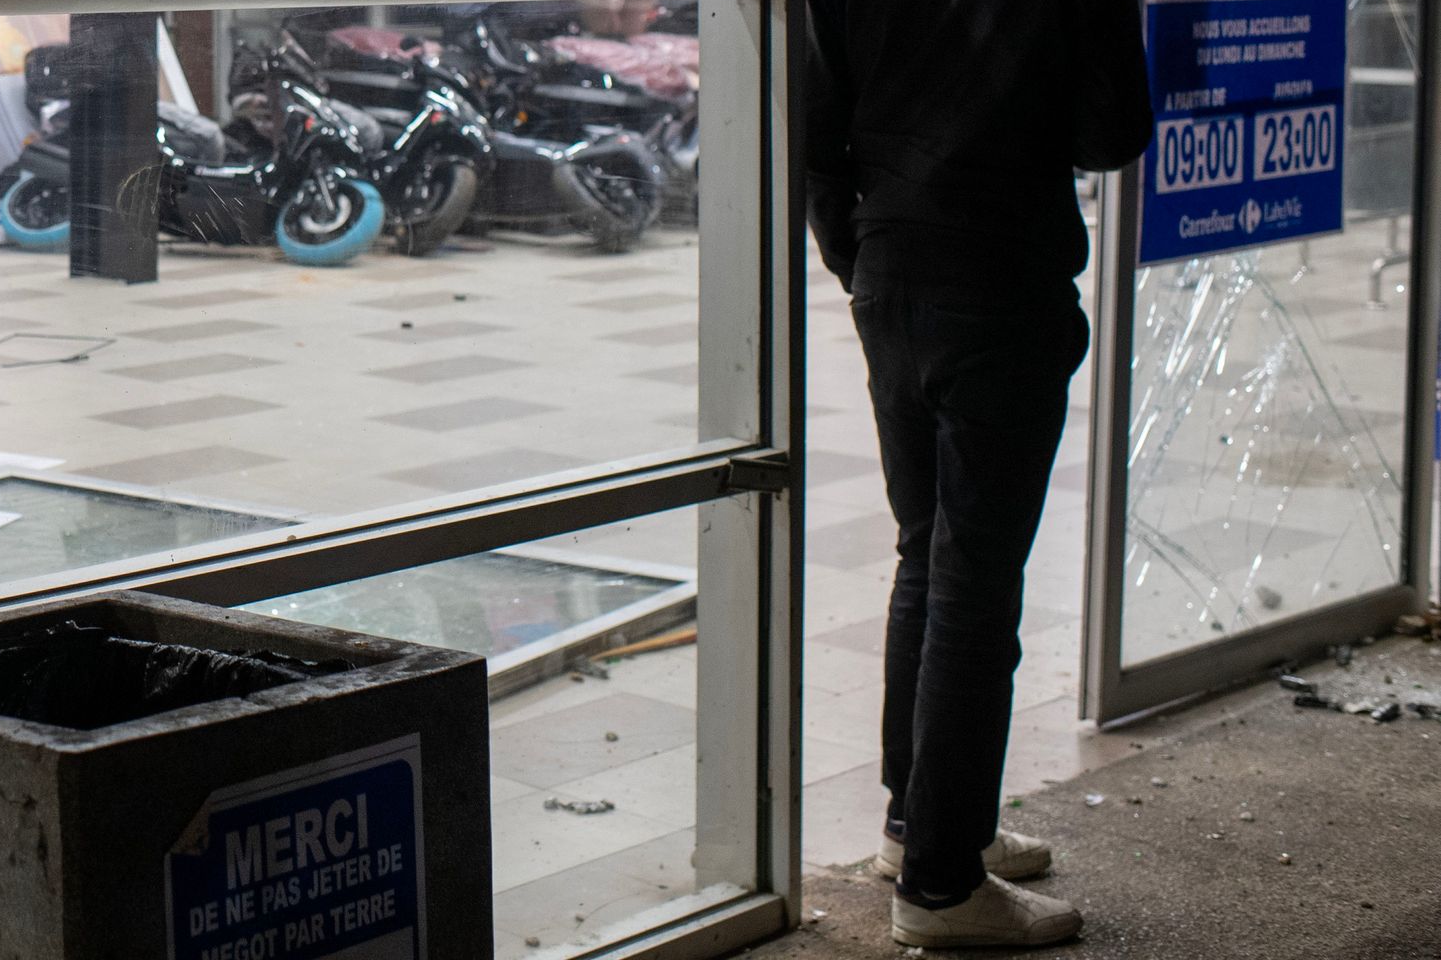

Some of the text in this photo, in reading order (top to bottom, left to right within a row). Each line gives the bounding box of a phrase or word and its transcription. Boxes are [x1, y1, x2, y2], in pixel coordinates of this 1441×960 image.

[1221, 18, 1248, 38] VOUS
[1243, 43, 1257, 63] AU
[1212, 87, 1227, 107] DE
[1164, 119, 1238, 186] 09:00
[1262, 111, 1332, 174] 23:00
[1179, 208, 1235, 239] Carrefour
[225, 792, 369, 890] MERCI
[189, 843, 403, 937] DE NE PAS JETER DE
[284, 912, 326, 949] PAR
[331, 888, 397, 937] TERRE
